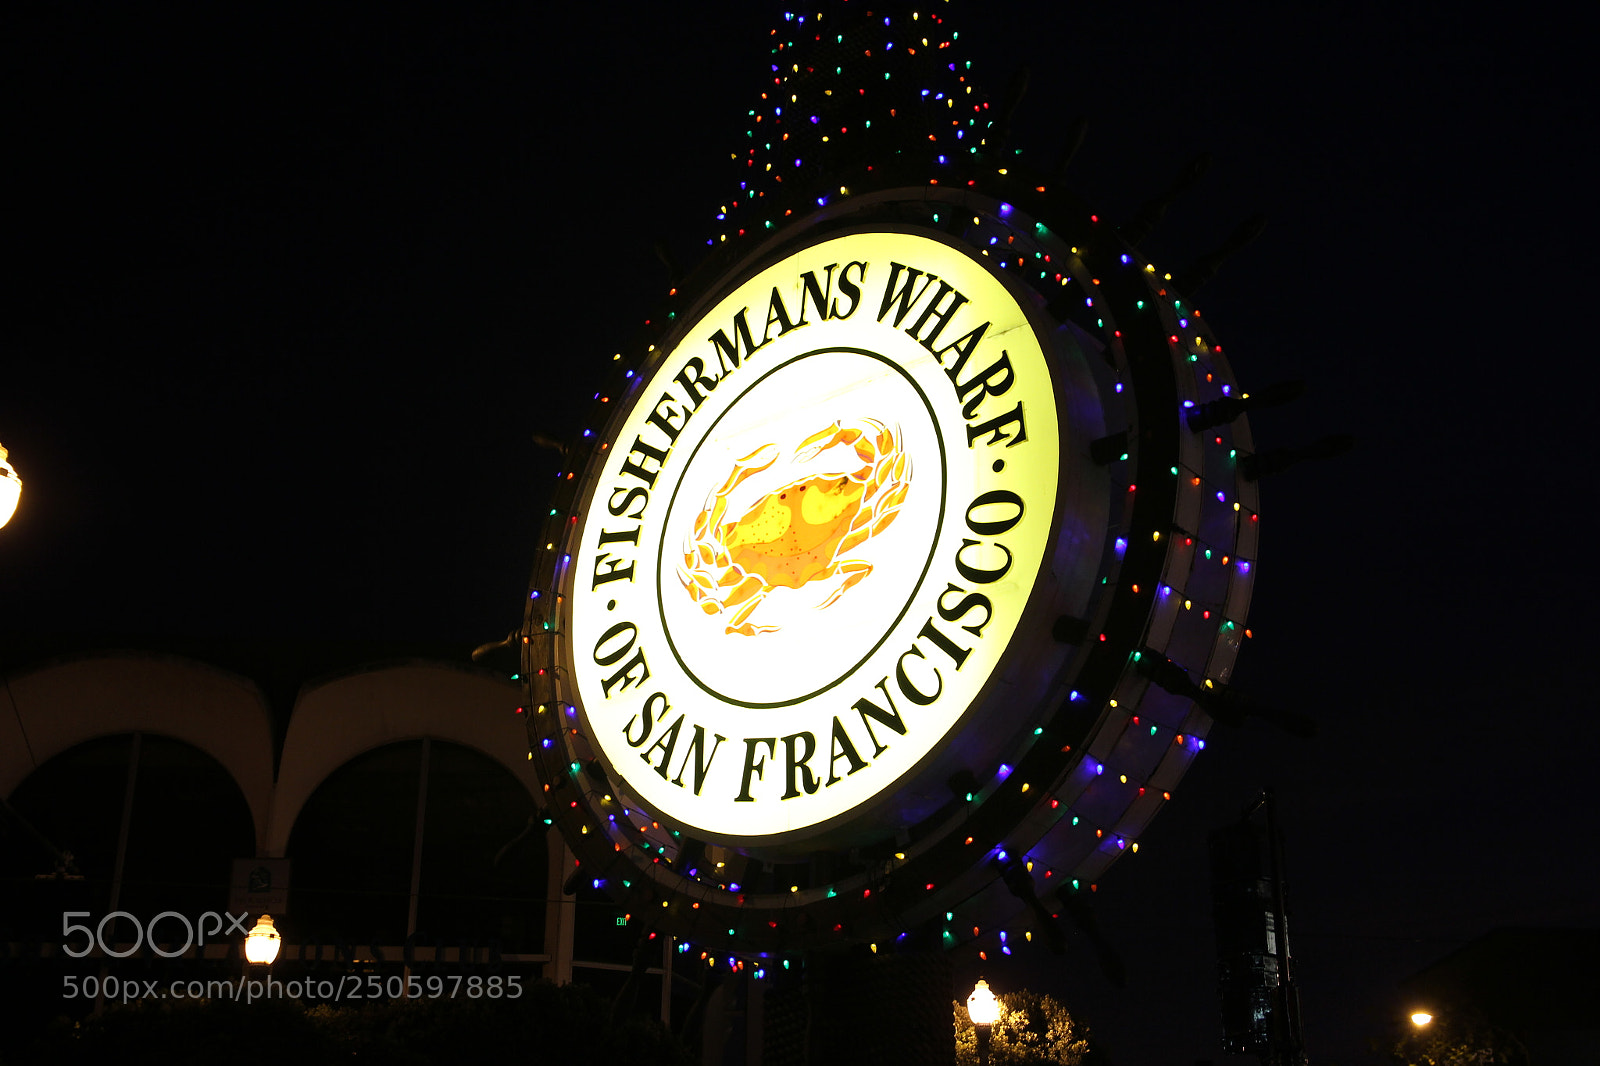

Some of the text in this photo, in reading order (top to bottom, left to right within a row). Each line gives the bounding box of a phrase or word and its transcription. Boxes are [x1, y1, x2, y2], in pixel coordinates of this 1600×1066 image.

[592, 261, 1028, 591] FISHERMANS WHARF
[592, 489, 1026, 803] OF SAN FRANCISCO
[616, 917, 628, 926] EXIT
